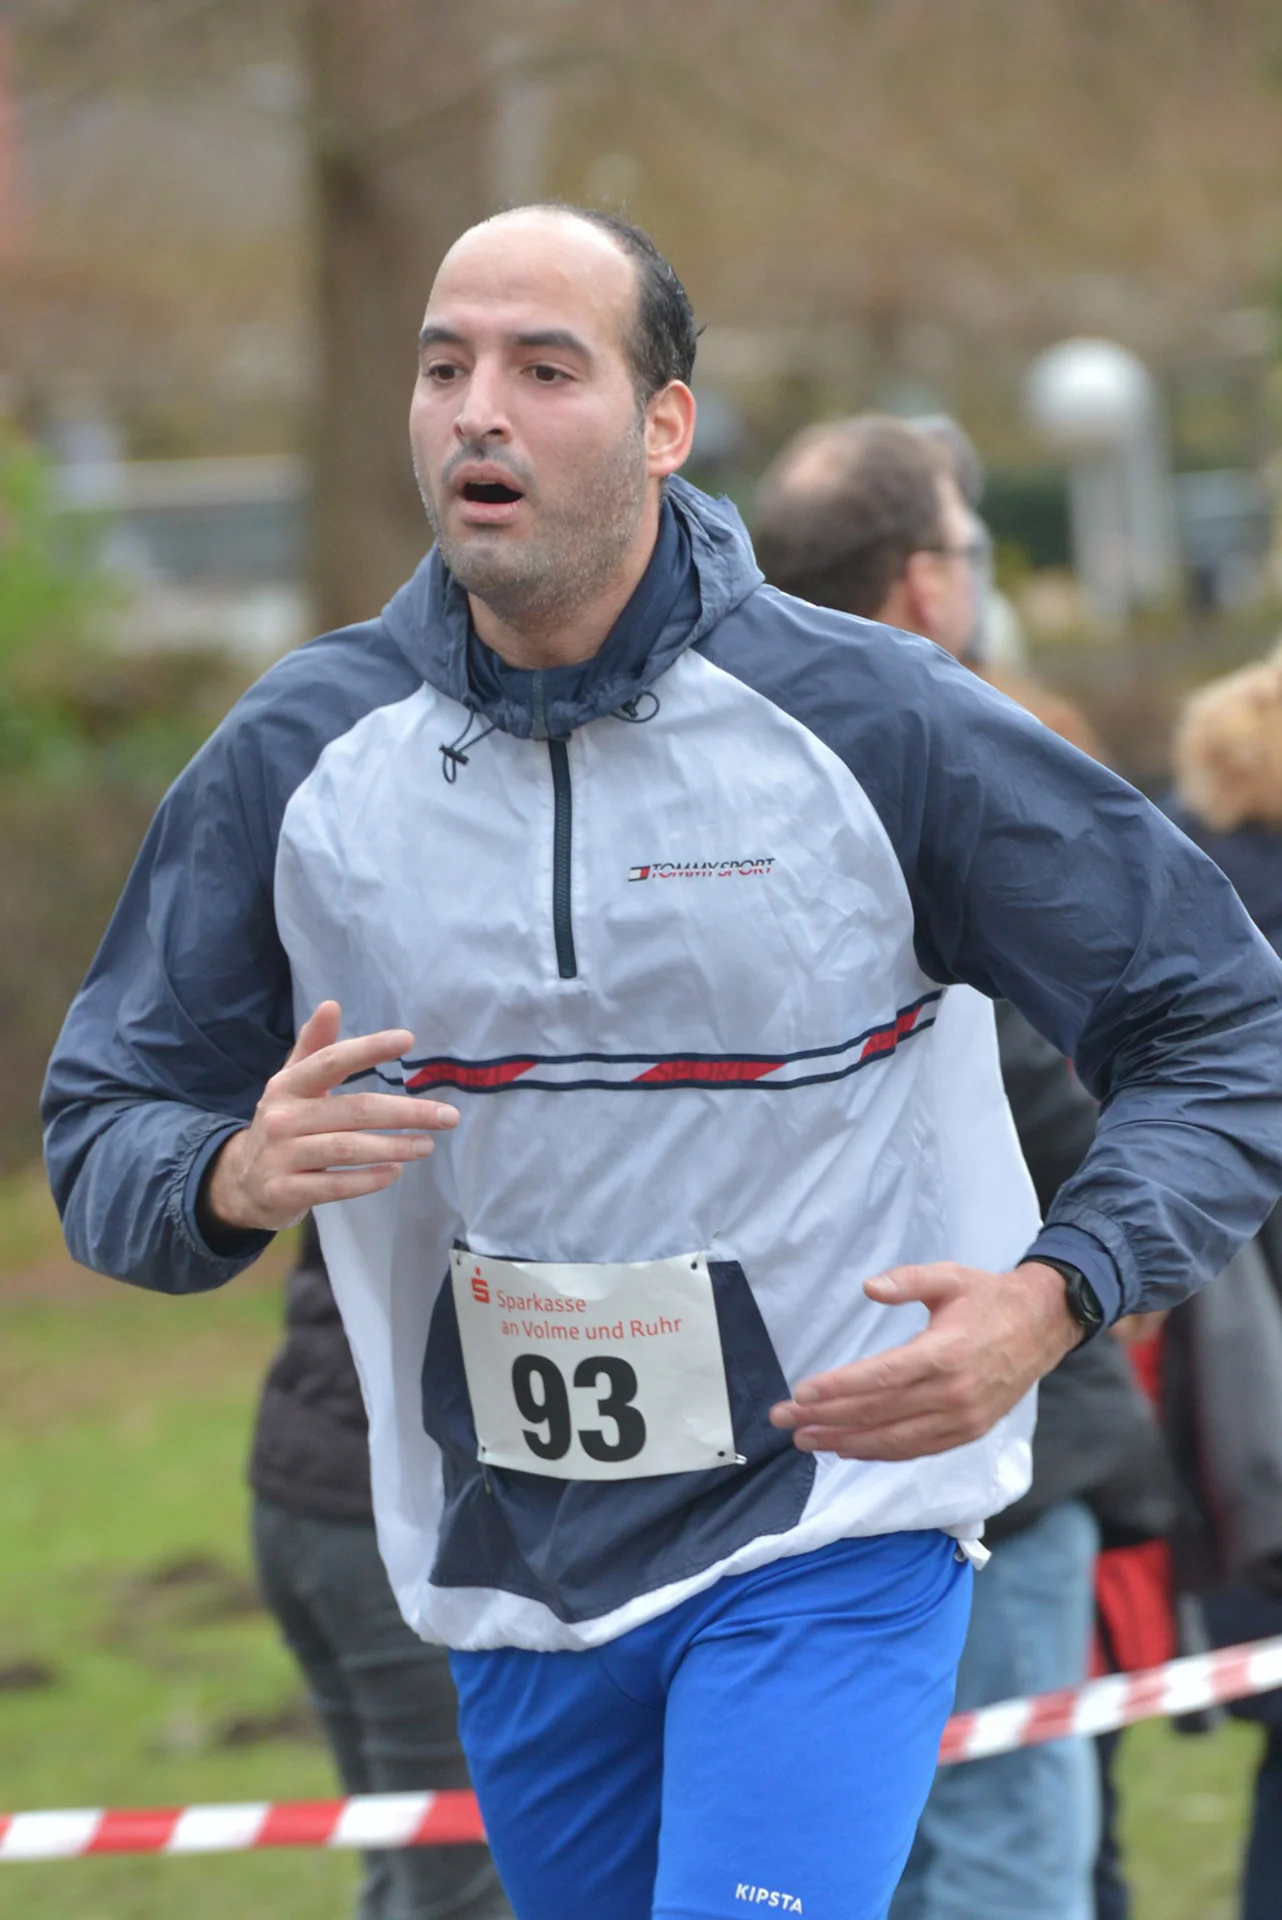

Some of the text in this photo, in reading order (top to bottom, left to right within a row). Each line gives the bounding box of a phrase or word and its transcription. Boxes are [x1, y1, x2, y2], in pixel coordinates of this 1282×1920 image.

[641, 1061, 748, 1082] SPORT
[496, 1290, 587, 1313] Sparkasse
[501, 1317, 683, 1340] an Volme und Ruhr
[512, 1353, 647, 1463] 93
[735, 1883, 803, 1915] KIPSTA
